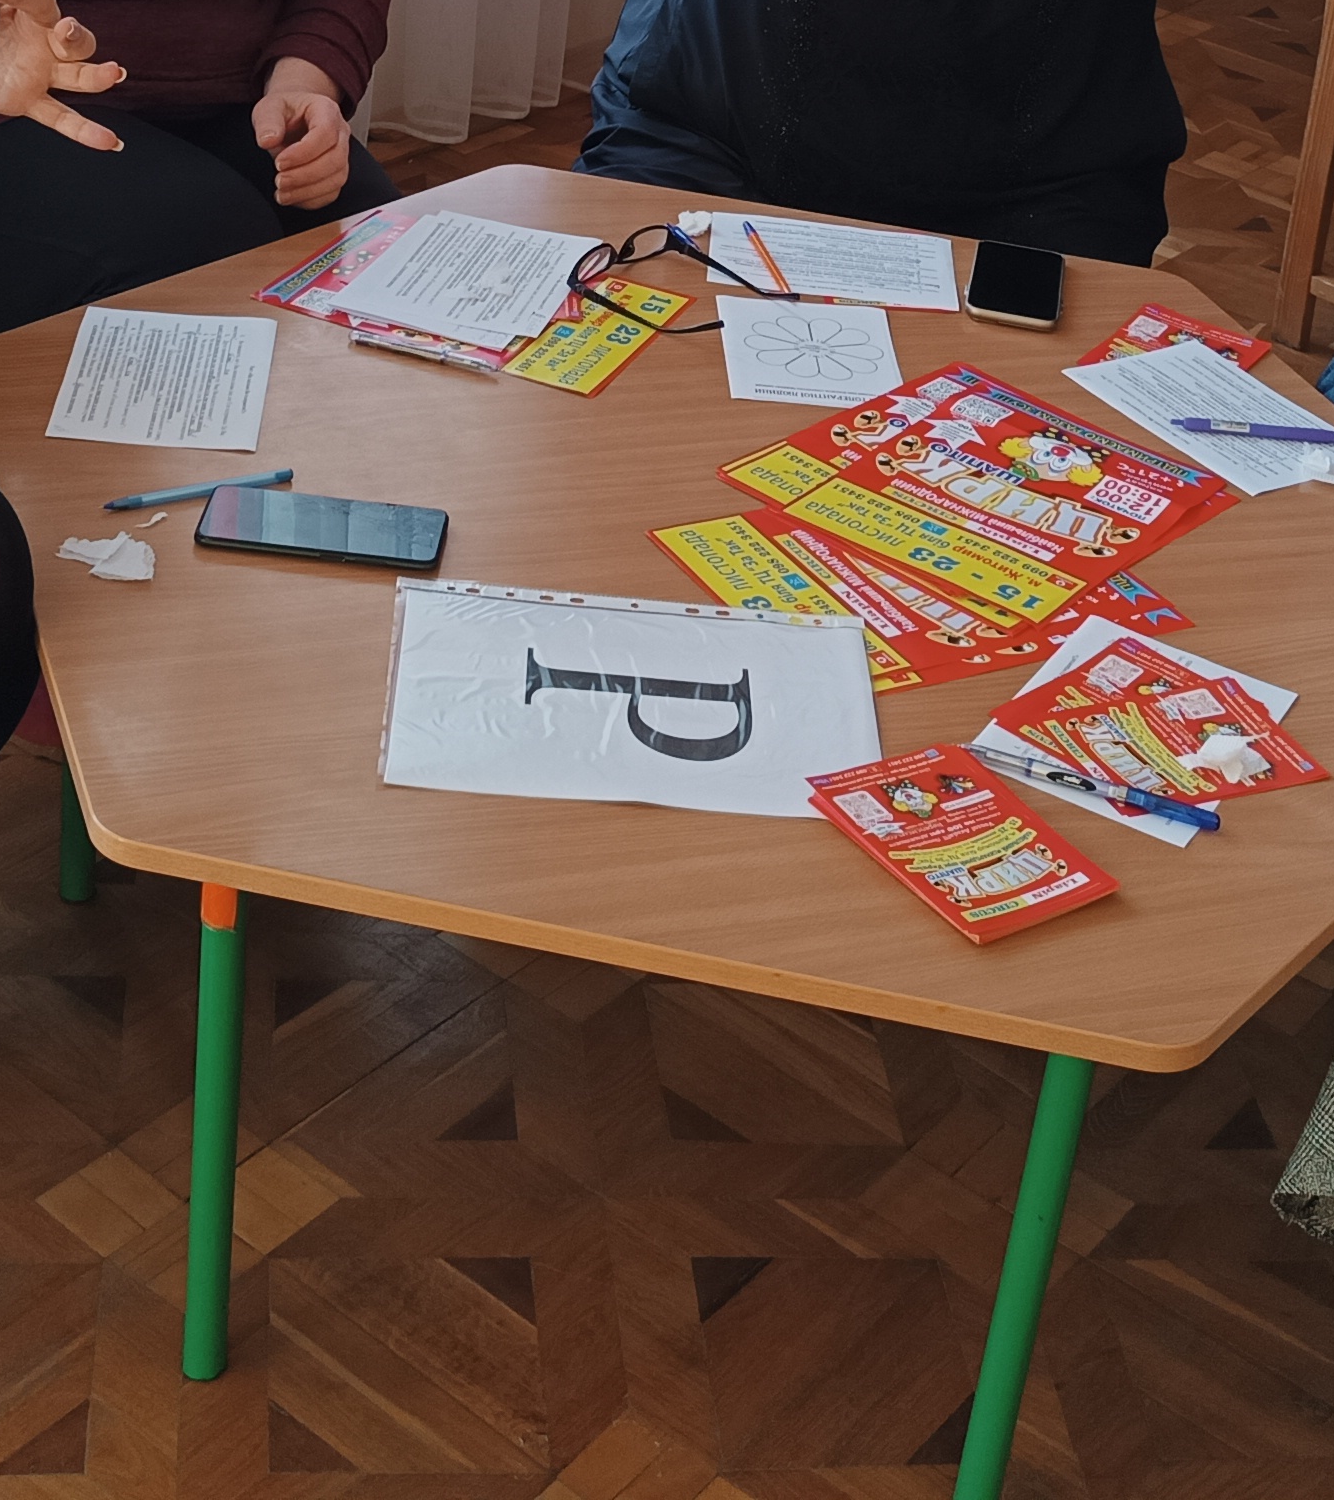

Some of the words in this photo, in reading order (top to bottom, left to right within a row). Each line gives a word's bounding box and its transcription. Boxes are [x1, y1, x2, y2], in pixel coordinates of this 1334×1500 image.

[639, 293, 672, 315] 15
[604, 323, 640, 347] 23
[928, 441, 1022, 483] ШАПІТО
[749, 464, 804, 497] опада
[832, 483, 866, 501] 3451
[1102, 477, 1162, 507] 16:00
[865, 497, 893, 512] 222
[890, 490, 957, 521] CIRCUS
[900, 450, 1105, 546] ЦИРК
[1094, 487, 1155, 517] 12:00
[802, 498, 905, 548] листопада
[894, 509, 920, 524] 098
[725, 519, 753, 542] 3451
[895, 522, 915, 536] ТЦ
[917, 531, 950, 550] біля
[748, 539, 771, 558] 222
[955, 534, 990, 552] 3451
[678, 529, 753, 591] листопада
[766, 556, 790, 575] 098
[782, 538, 832, 579] CIRCUS
[906, 545, 960, 573] 23
[950, 544, 1023, 581] Житомир
[991, 549, 1019, 565] 222
[752, 569, 775, 585] ТЦ
[1020, 562, 1049, 577] 099
[770, 582, 798, 606] біля
[991, 582, 1044, 610] 15
[1049, 723, 1084, 758] CIRCUS
[1078, 724, 1163, 792] ЦИРК
[943, 851, 1051, 898] ЦИРК
[1030, 877, 1078, 900] LiapiN
[968, 899, 1019, 919] CIRCUS
